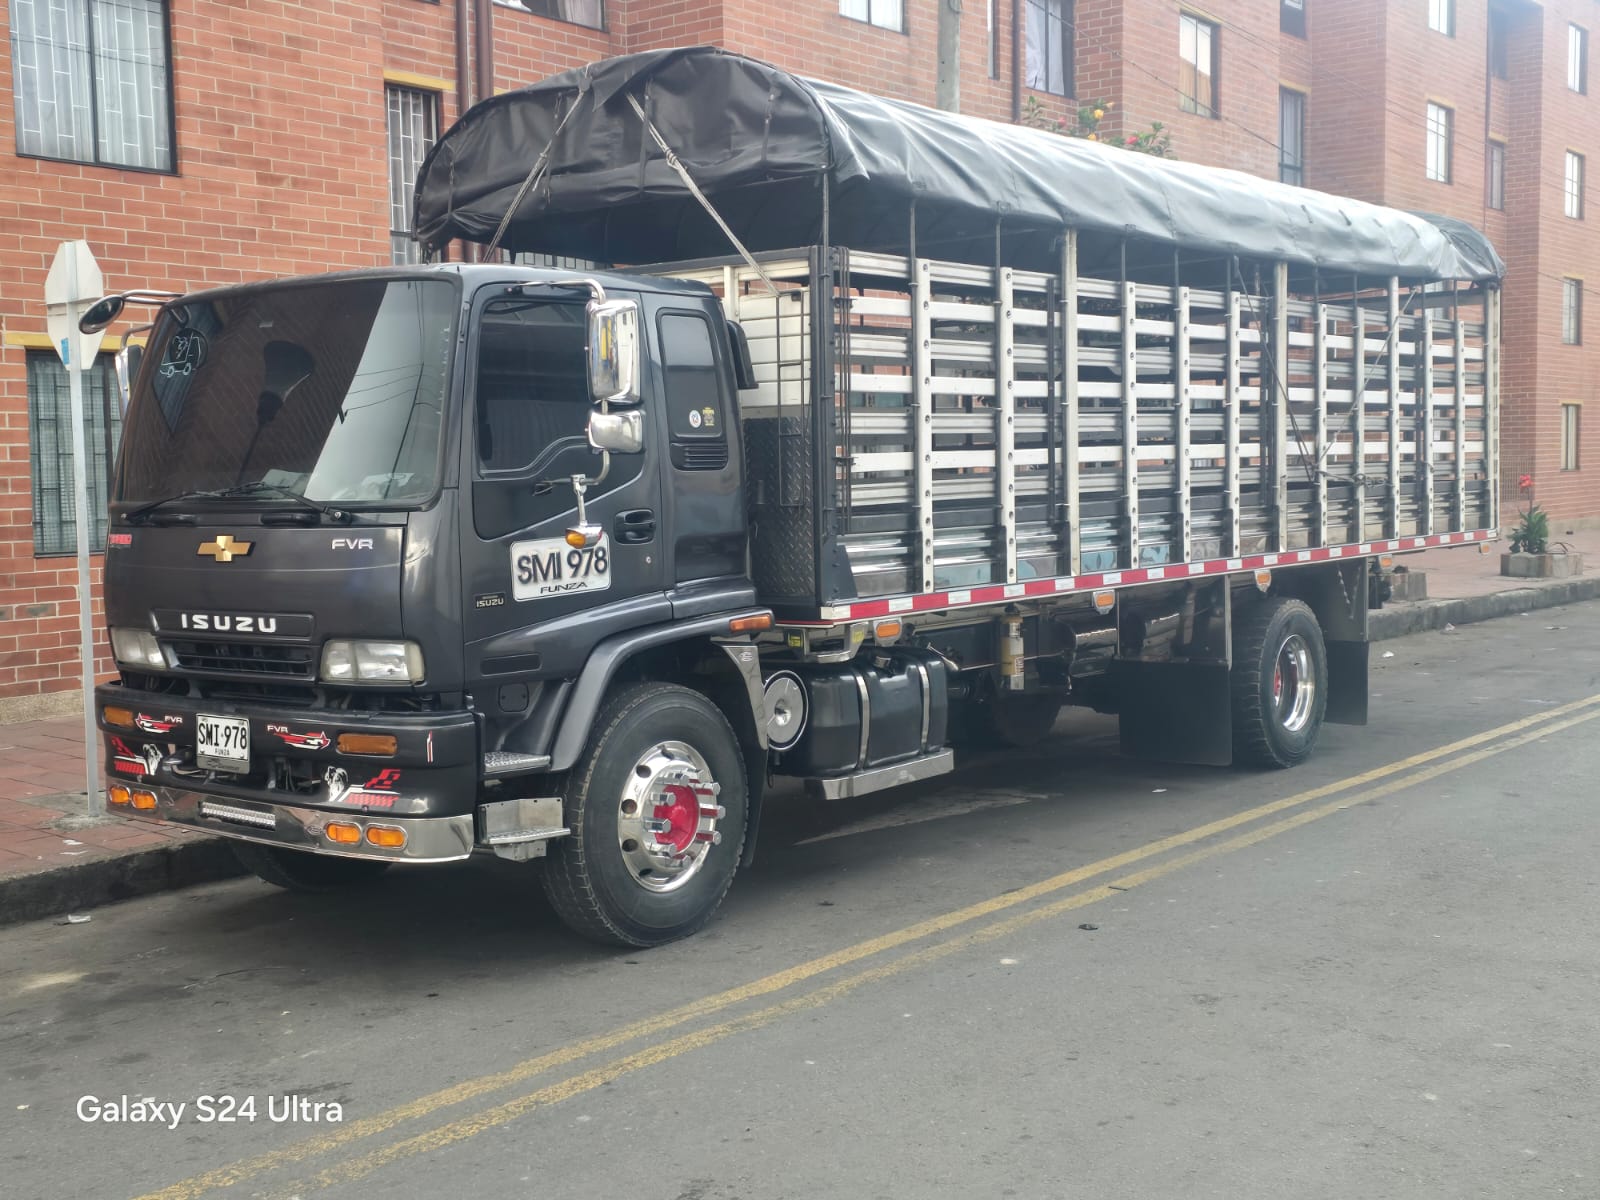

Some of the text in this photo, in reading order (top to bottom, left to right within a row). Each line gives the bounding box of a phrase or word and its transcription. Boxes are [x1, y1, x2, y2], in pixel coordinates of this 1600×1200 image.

[331, 538, 374, 550] FVR
[517, 546, 608, 585] SMI 978
[540, 581, 588, 594] FUNZA
[476, 597, 504, 608] ISUZU
[181, 613, 277, 633] ISUZU
[164, 715, 183, 723] FVR
[267, 725, 288, 733] FVR
[198, 722, 247, 749] SMI 978
